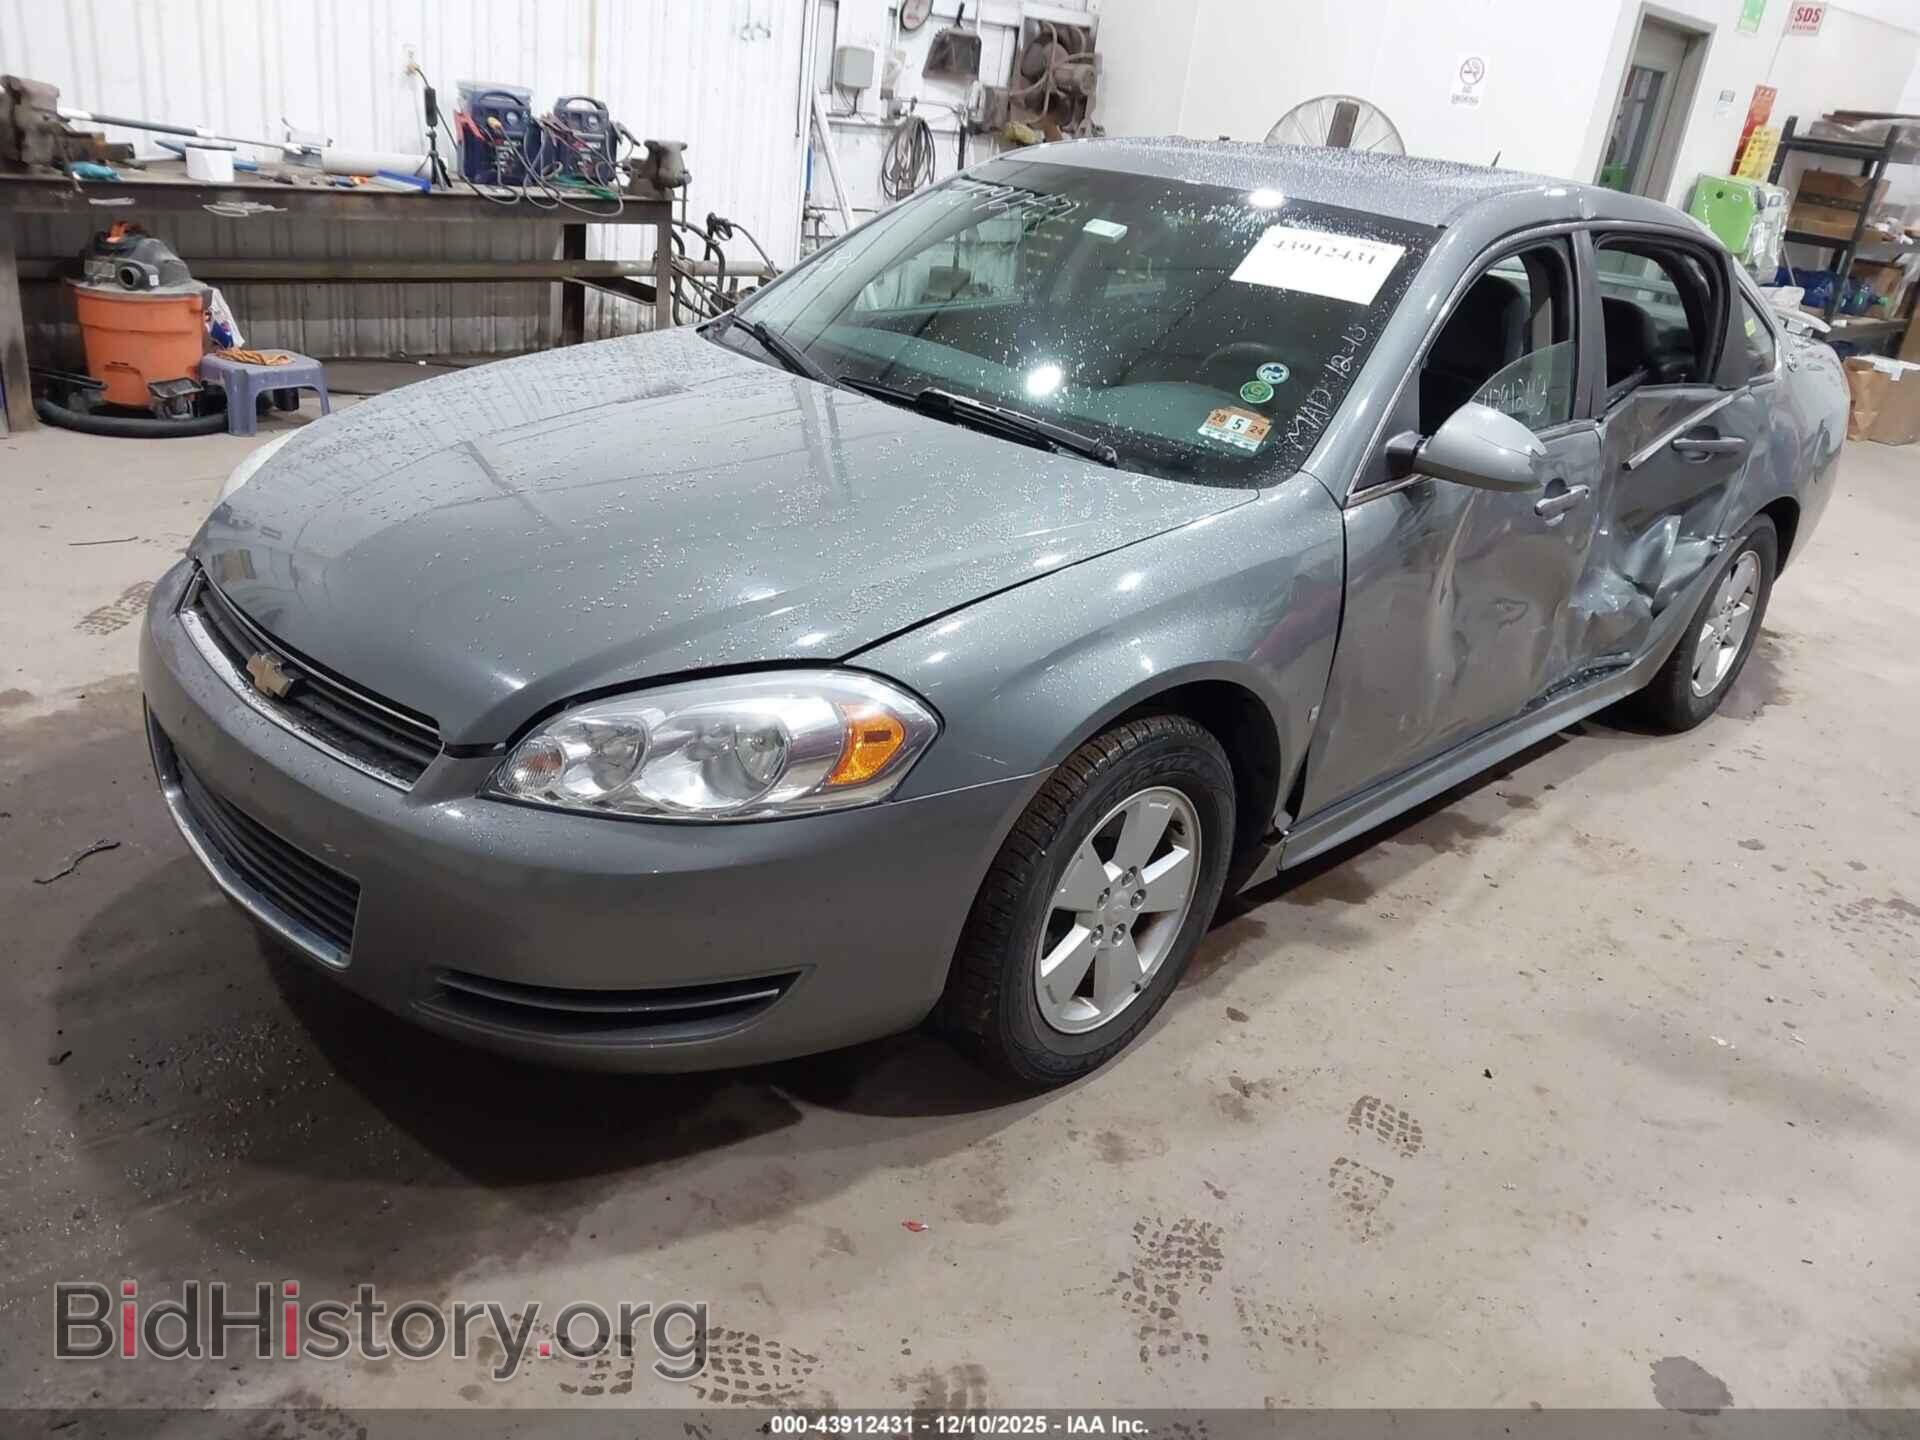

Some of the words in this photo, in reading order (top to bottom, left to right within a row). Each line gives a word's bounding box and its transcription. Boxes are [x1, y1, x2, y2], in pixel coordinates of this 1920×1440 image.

[1795, 8, 1822, 23] SDS
[1272, 240, 1377, 265] 43912431
[1211, 412, 1227, 423] 20
[1232, 418, 1244, 431] 5
[1248, 425, 1265, 436] 24
